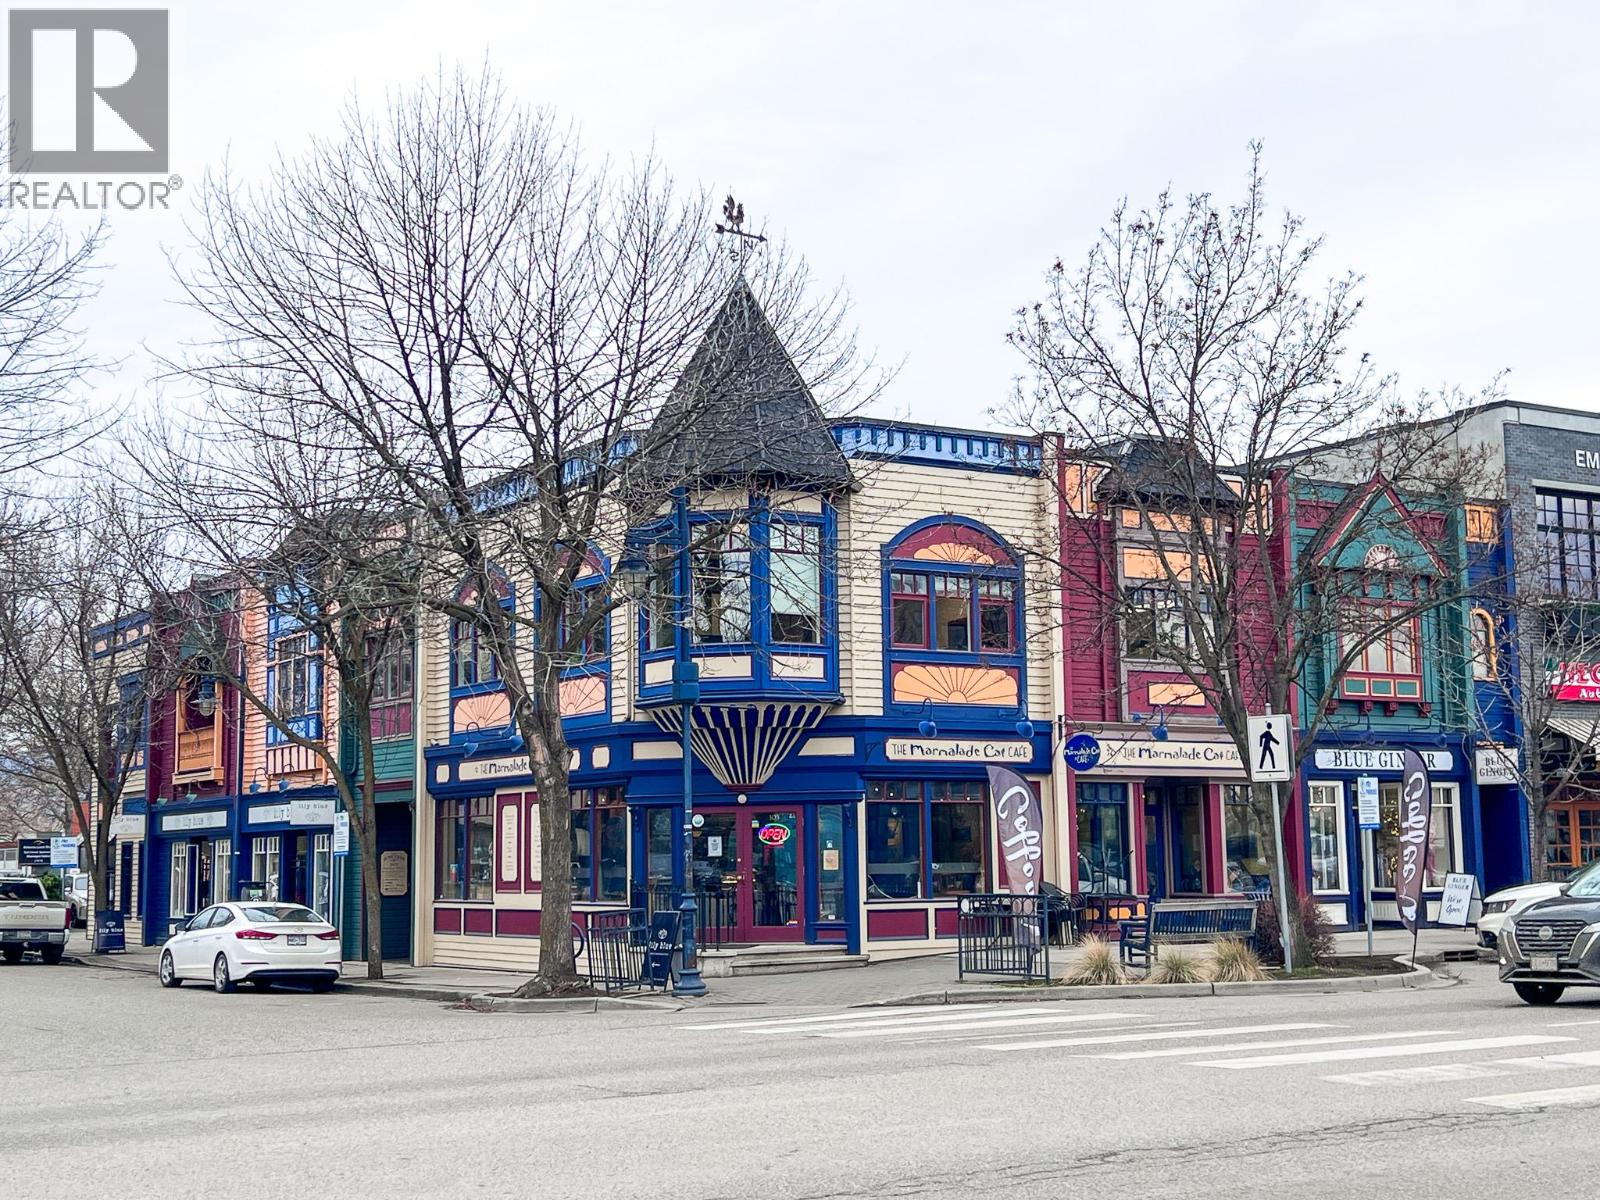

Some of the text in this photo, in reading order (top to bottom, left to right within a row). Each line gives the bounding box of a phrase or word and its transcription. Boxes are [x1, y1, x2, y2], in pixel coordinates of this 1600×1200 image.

[892, 743, 907, 755] THE
[910, 743, 980, 757] Marmalade
[984, 744, 1005, 758] Cat
[1138, 746, 1201, 761] Marmalade
[488, 758, 527, 774] Marmalade
[1334, 751, 1437, 769] BLUE GINR
[760, 827, 788, 841] OPEN
